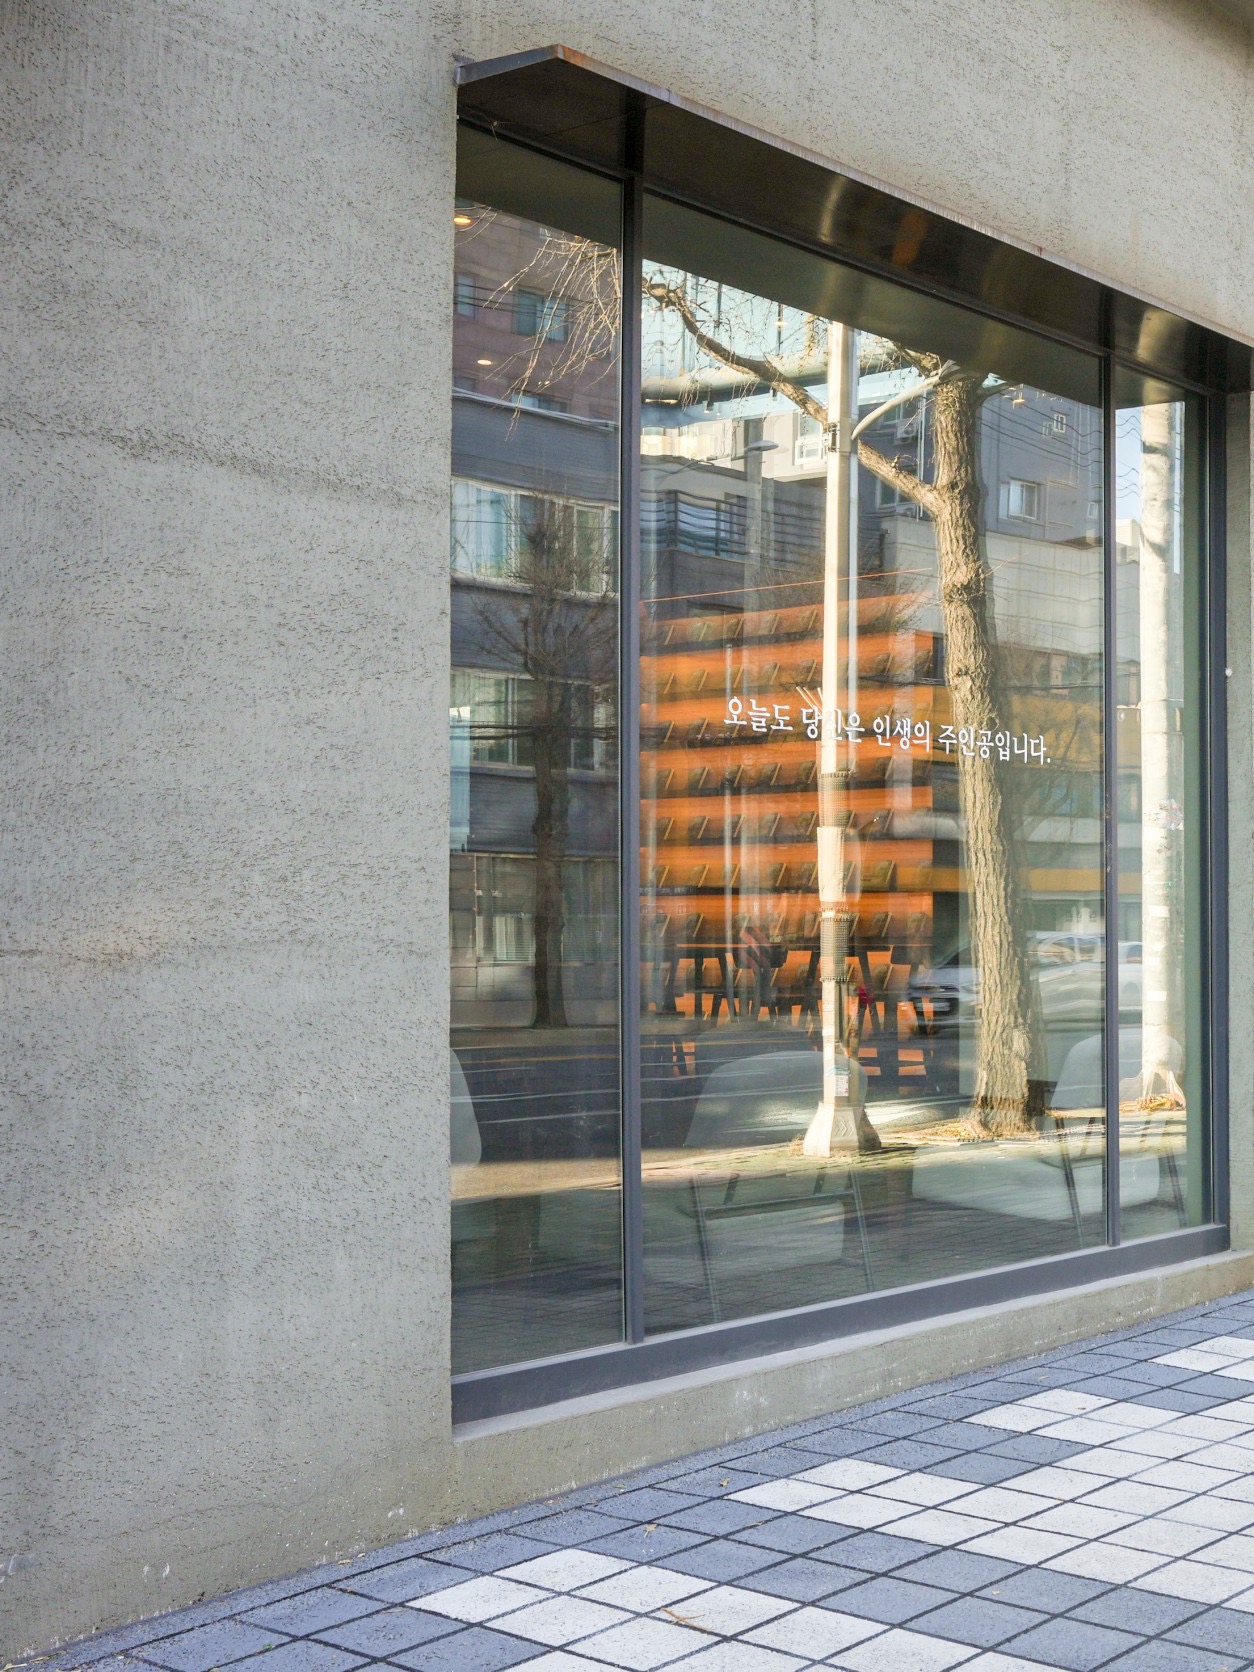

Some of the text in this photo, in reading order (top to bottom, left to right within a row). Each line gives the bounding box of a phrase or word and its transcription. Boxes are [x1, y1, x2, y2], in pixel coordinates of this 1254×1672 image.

[723, 695, 1051, 766] 오늘도 당신은 인생의 주인공입니다.
